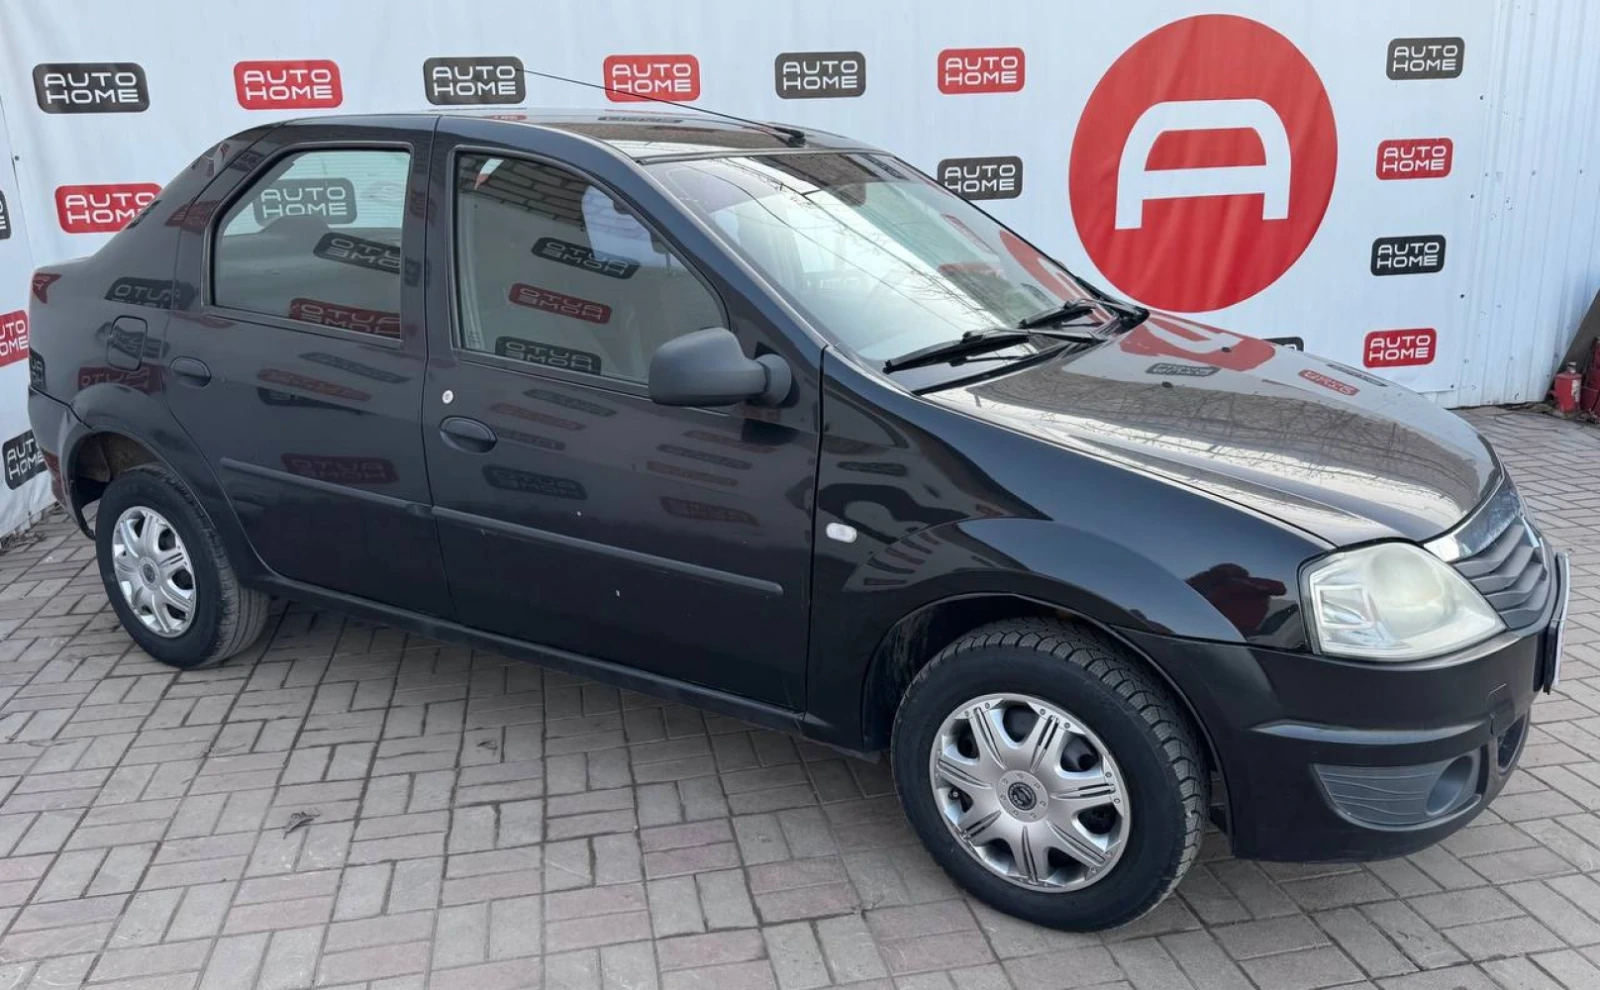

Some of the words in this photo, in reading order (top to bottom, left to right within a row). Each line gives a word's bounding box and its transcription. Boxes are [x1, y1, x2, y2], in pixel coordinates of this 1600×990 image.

[1394, 45, 1458, 58] AUTO
[612, 63, 691, 78] AUTO
[783, 60, 858, 75] AUTO
[945, 56, 1018, 70] AUTO
[1393, 59, 1456, 72] HOME
[44, 72, 136, 87] AUTO
[244, 69, 331, 84] AUTO
[432, 66, 516, 80] AUTO
[945, 71, 1017, 85] HOME
[433, 81, 516, 96] HOME
[613, 79, 691, 93] HOME
[783, 75, 857, 90] HOME
[45, 89, 139, 104] HOME
[245, 85, 333, 100] HOME
[1384, 145, 1446, 159] AUTO
[945, 164, 1016, 179] AUTO
[1115, 98, 1291, 230] A
[1382, 159, 1445, 172] HOME
[944, 178, 1015, 193] HOME
[65, 192, 155, 208] AUTO
[260, 186, 346, 203] AUTO
[67, 208, 142, 224] HOM
[262, 202, 347, 219] HOME
[1378, 242, 1440, 256] AUTO
[1377, 254, 1438, 268] HOME
[0, 319, 26, 340] UTO
[0, 335, 29, 356] OME
[1370, 335, 1431, 349] AUTO
[1369, 347, 1429, 361] HOME
[7, 438, 39, 464] AUT
